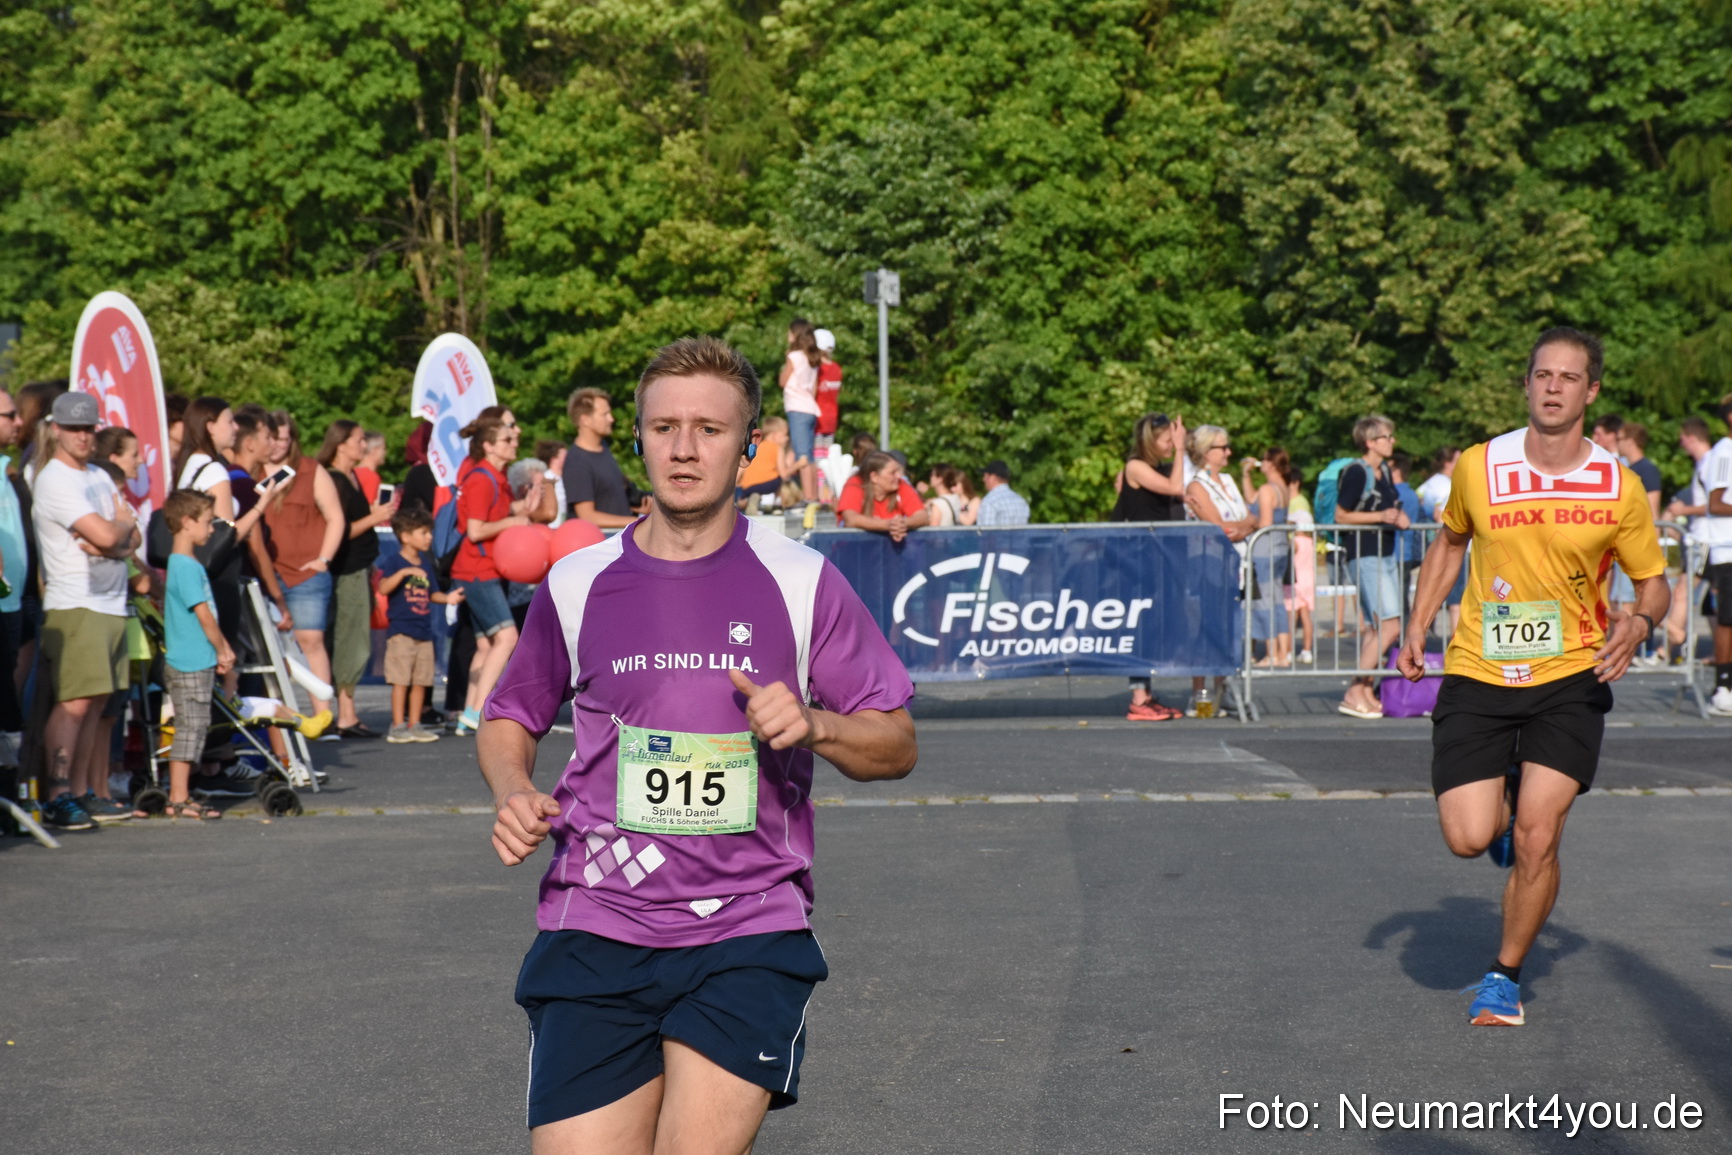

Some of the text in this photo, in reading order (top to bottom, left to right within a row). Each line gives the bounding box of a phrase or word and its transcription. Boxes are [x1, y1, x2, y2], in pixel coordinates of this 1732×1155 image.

[1489, 504, 1619, 530] MAX BÖGL
[940, 588, 1153, 633] Fischer
[1491, 621, 1552, 644] 1702
[958, 635, 1136, 658] AUTOMOBILE
[612, 653, 759, 674] WIR SIND LILA.
[637, 748, 693, 764] firmenlauf
[724, 759, 750, 769] 2019
[645, 768, 726, 807] 915
[641, 815, 667, 825] FUCHS
[677, 818, 700, 826] Söhne
[702, 818, 729, 826] Service
[651, 806, 719, 818] Spille Daniel
